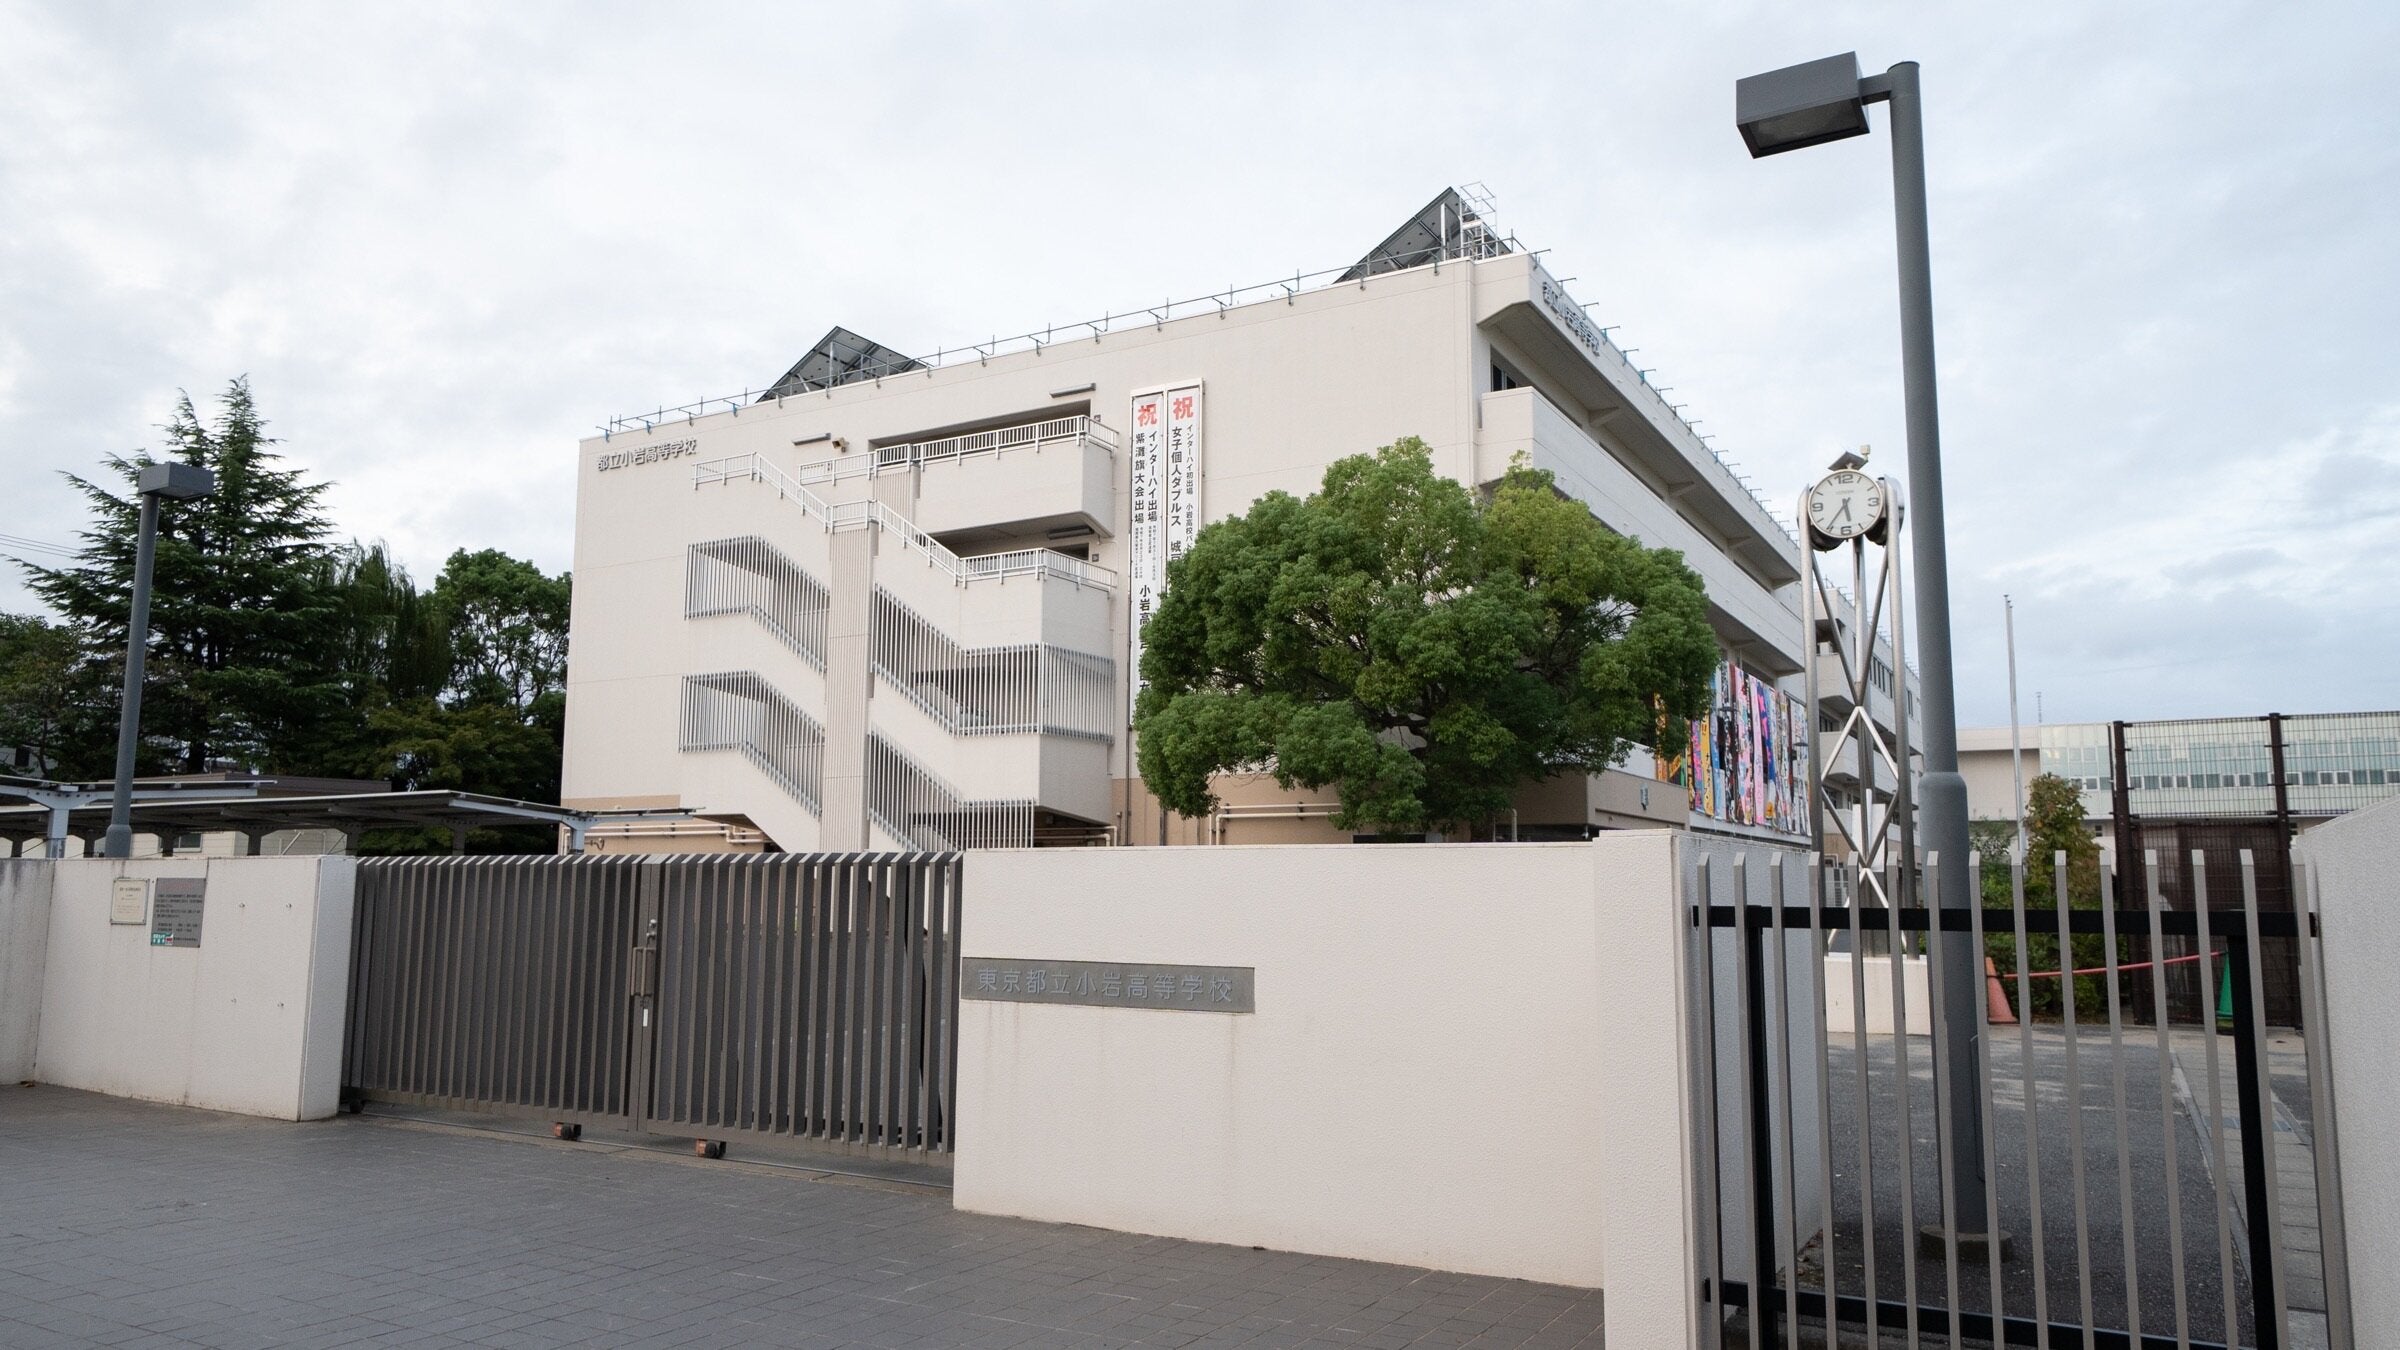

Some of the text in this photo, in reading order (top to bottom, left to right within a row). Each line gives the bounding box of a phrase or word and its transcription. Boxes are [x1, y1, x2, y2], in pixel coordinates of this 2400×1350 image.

[1137, 403, 1158, 427] 祝
[1172, 396, 1194, 421] 祝
[598, 437, 697, 471] 都立小岩高等学校
[1186, 424, 1194, 495] インターハイ初出場
[1148, 430, 1158, 522] インターハイ出場
[1171, 426, 1183, 527] 女子個人ダブルス
[1834, 474, 1854, 484] 12
[1812, 502, 1824, 512] 9
[1867, 497, 1880, 507] 3
[1840, 525, 1852, 536] 6
[977, 967, 1233, 1002] 東京都立小岩高等学校
